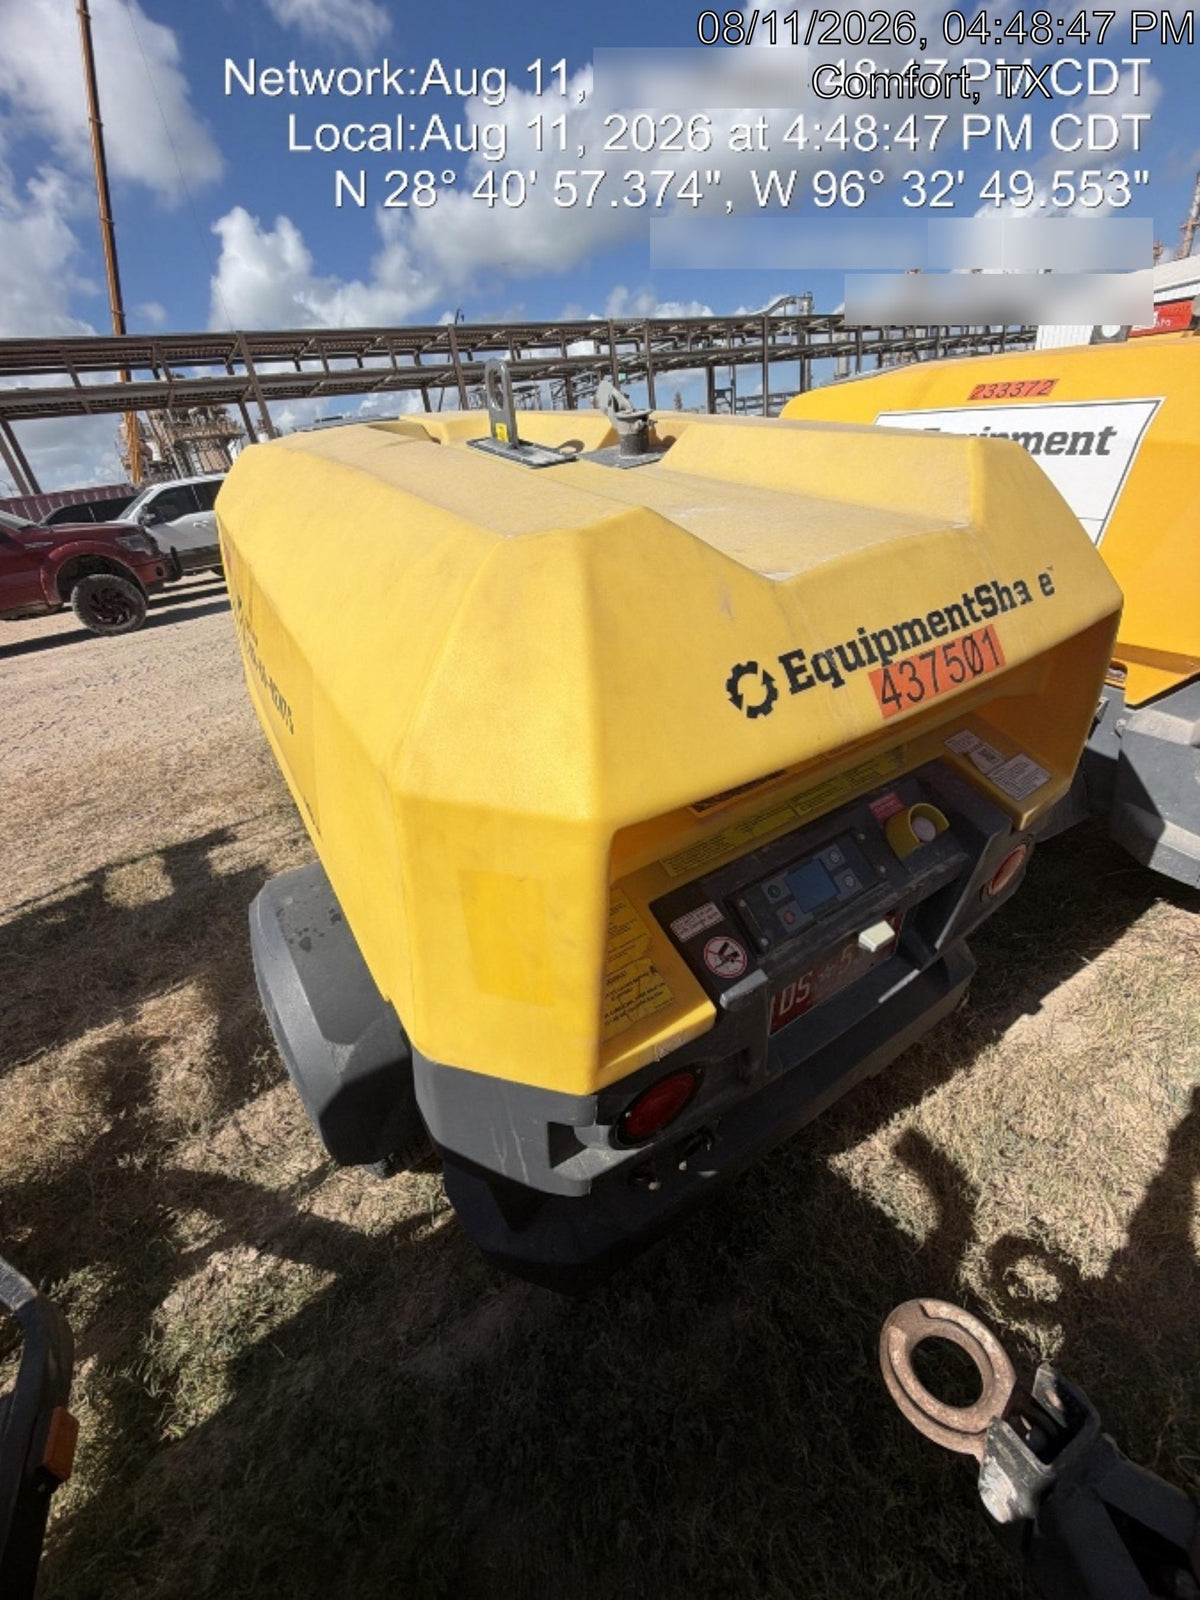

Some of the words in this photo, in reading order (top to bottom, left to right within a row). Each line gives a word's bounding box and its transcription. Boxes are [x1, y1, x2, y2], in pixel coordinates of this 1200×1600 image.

[968, 380, 1055, 400] 233372
[778, 571, 1055, 695] EquipmentShae
[880, 627, 1000, 710] 437501
